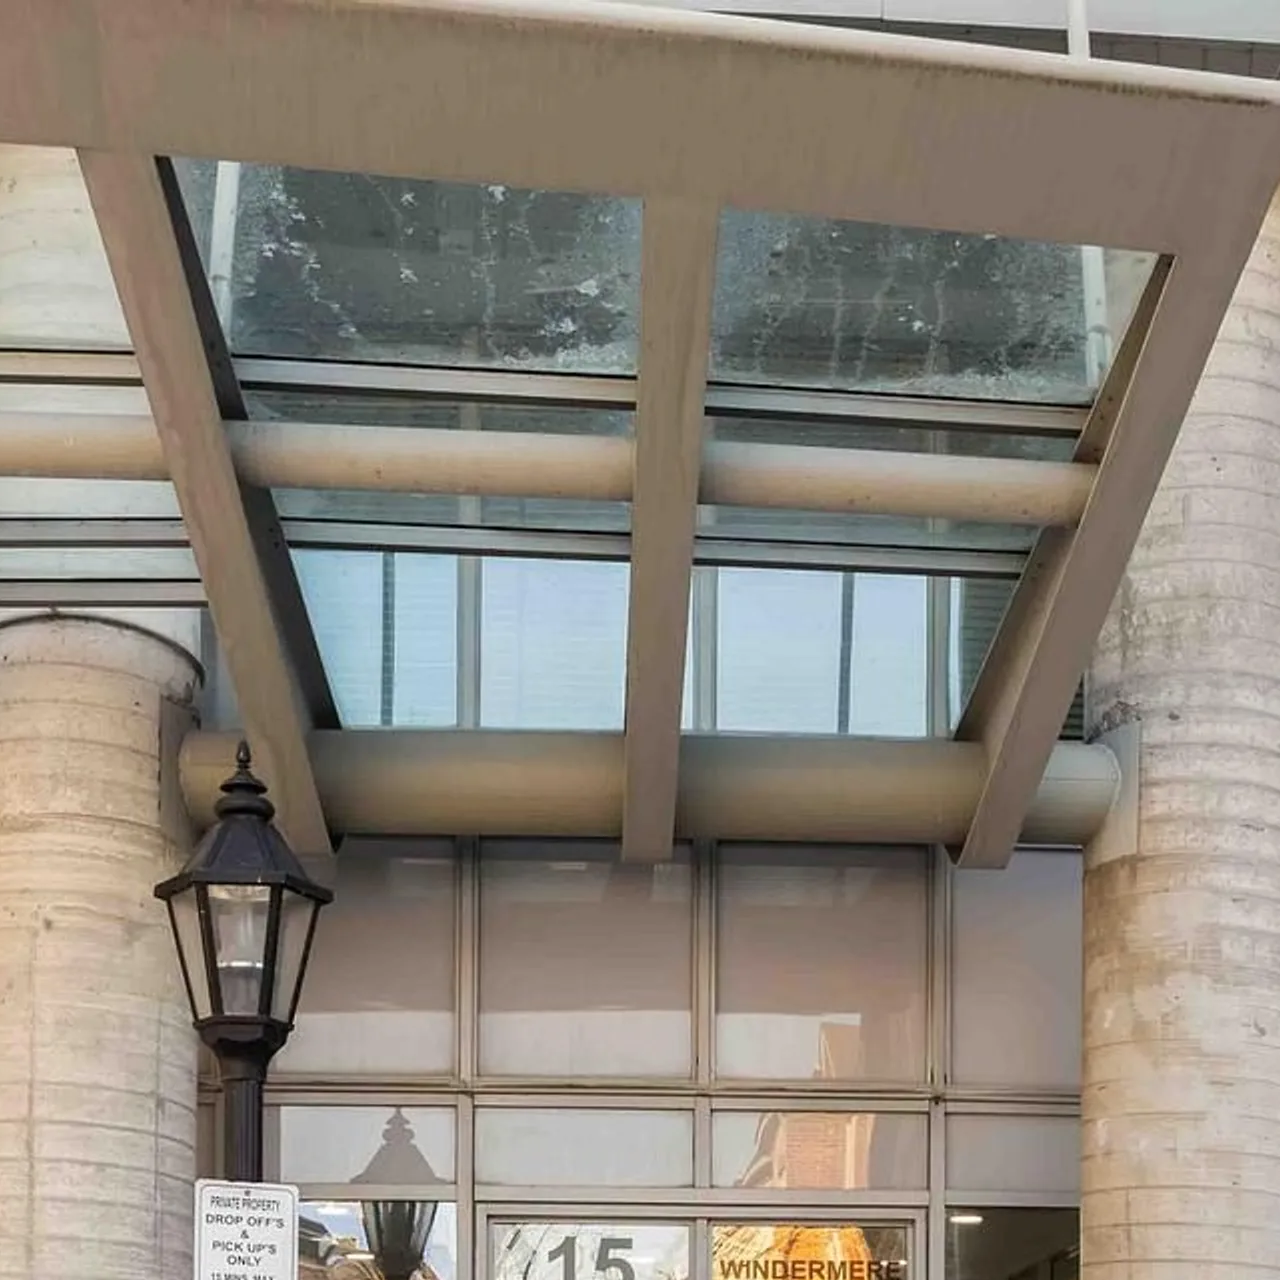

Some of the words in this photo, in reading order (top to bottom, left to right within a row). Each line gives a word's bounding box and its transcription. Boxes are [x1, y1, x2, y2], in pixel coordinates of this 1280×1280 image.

[211, 1196, 240, 1209] PRIVATE
[243, 1198, 280, 1211] PROPERTY
[206, 1214, 243, 1225] DROP
[240, 1229, 249, 1239] &
[212, 1240, 243, 1252] PICK
[227, 1255, 261, 1266] ONLY
